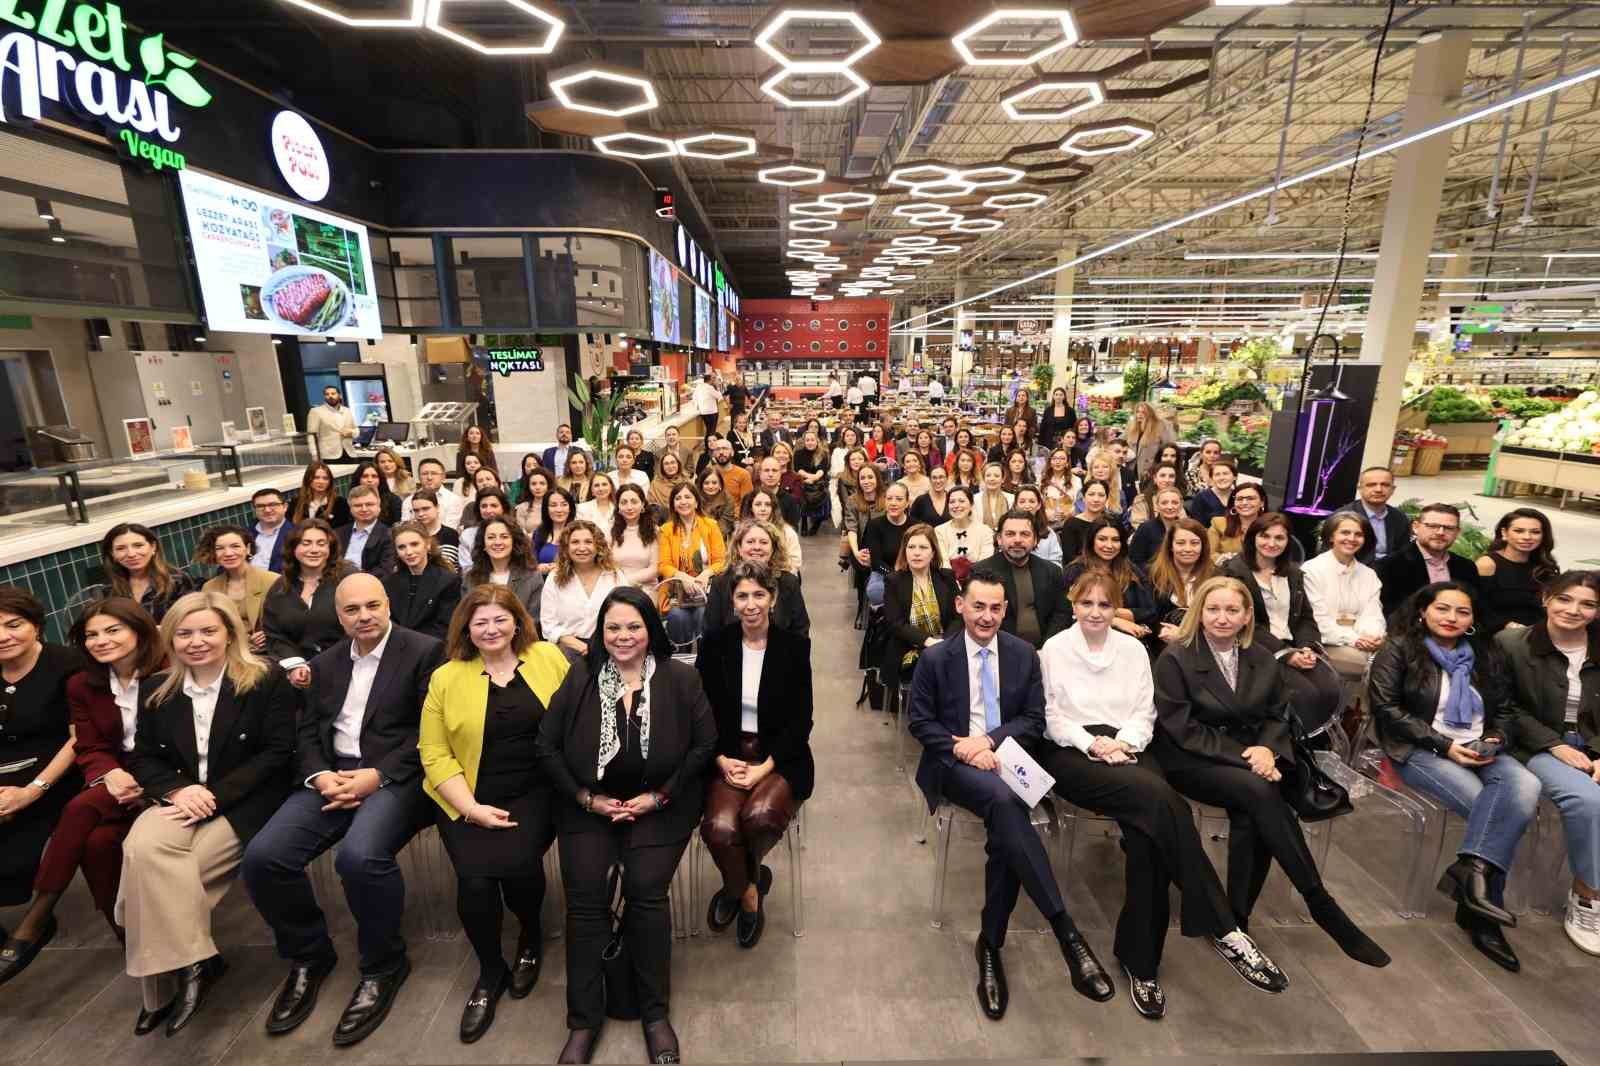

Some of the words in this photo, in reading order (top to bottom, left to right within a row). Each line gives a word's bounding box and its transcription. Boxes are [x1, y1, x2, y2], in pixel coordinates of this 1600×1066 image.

[120, 129, 186, 170] Vegan
[490, 349, 538, 360] TESLİMAT
[490, 360, 541, 374] NOKTASI
